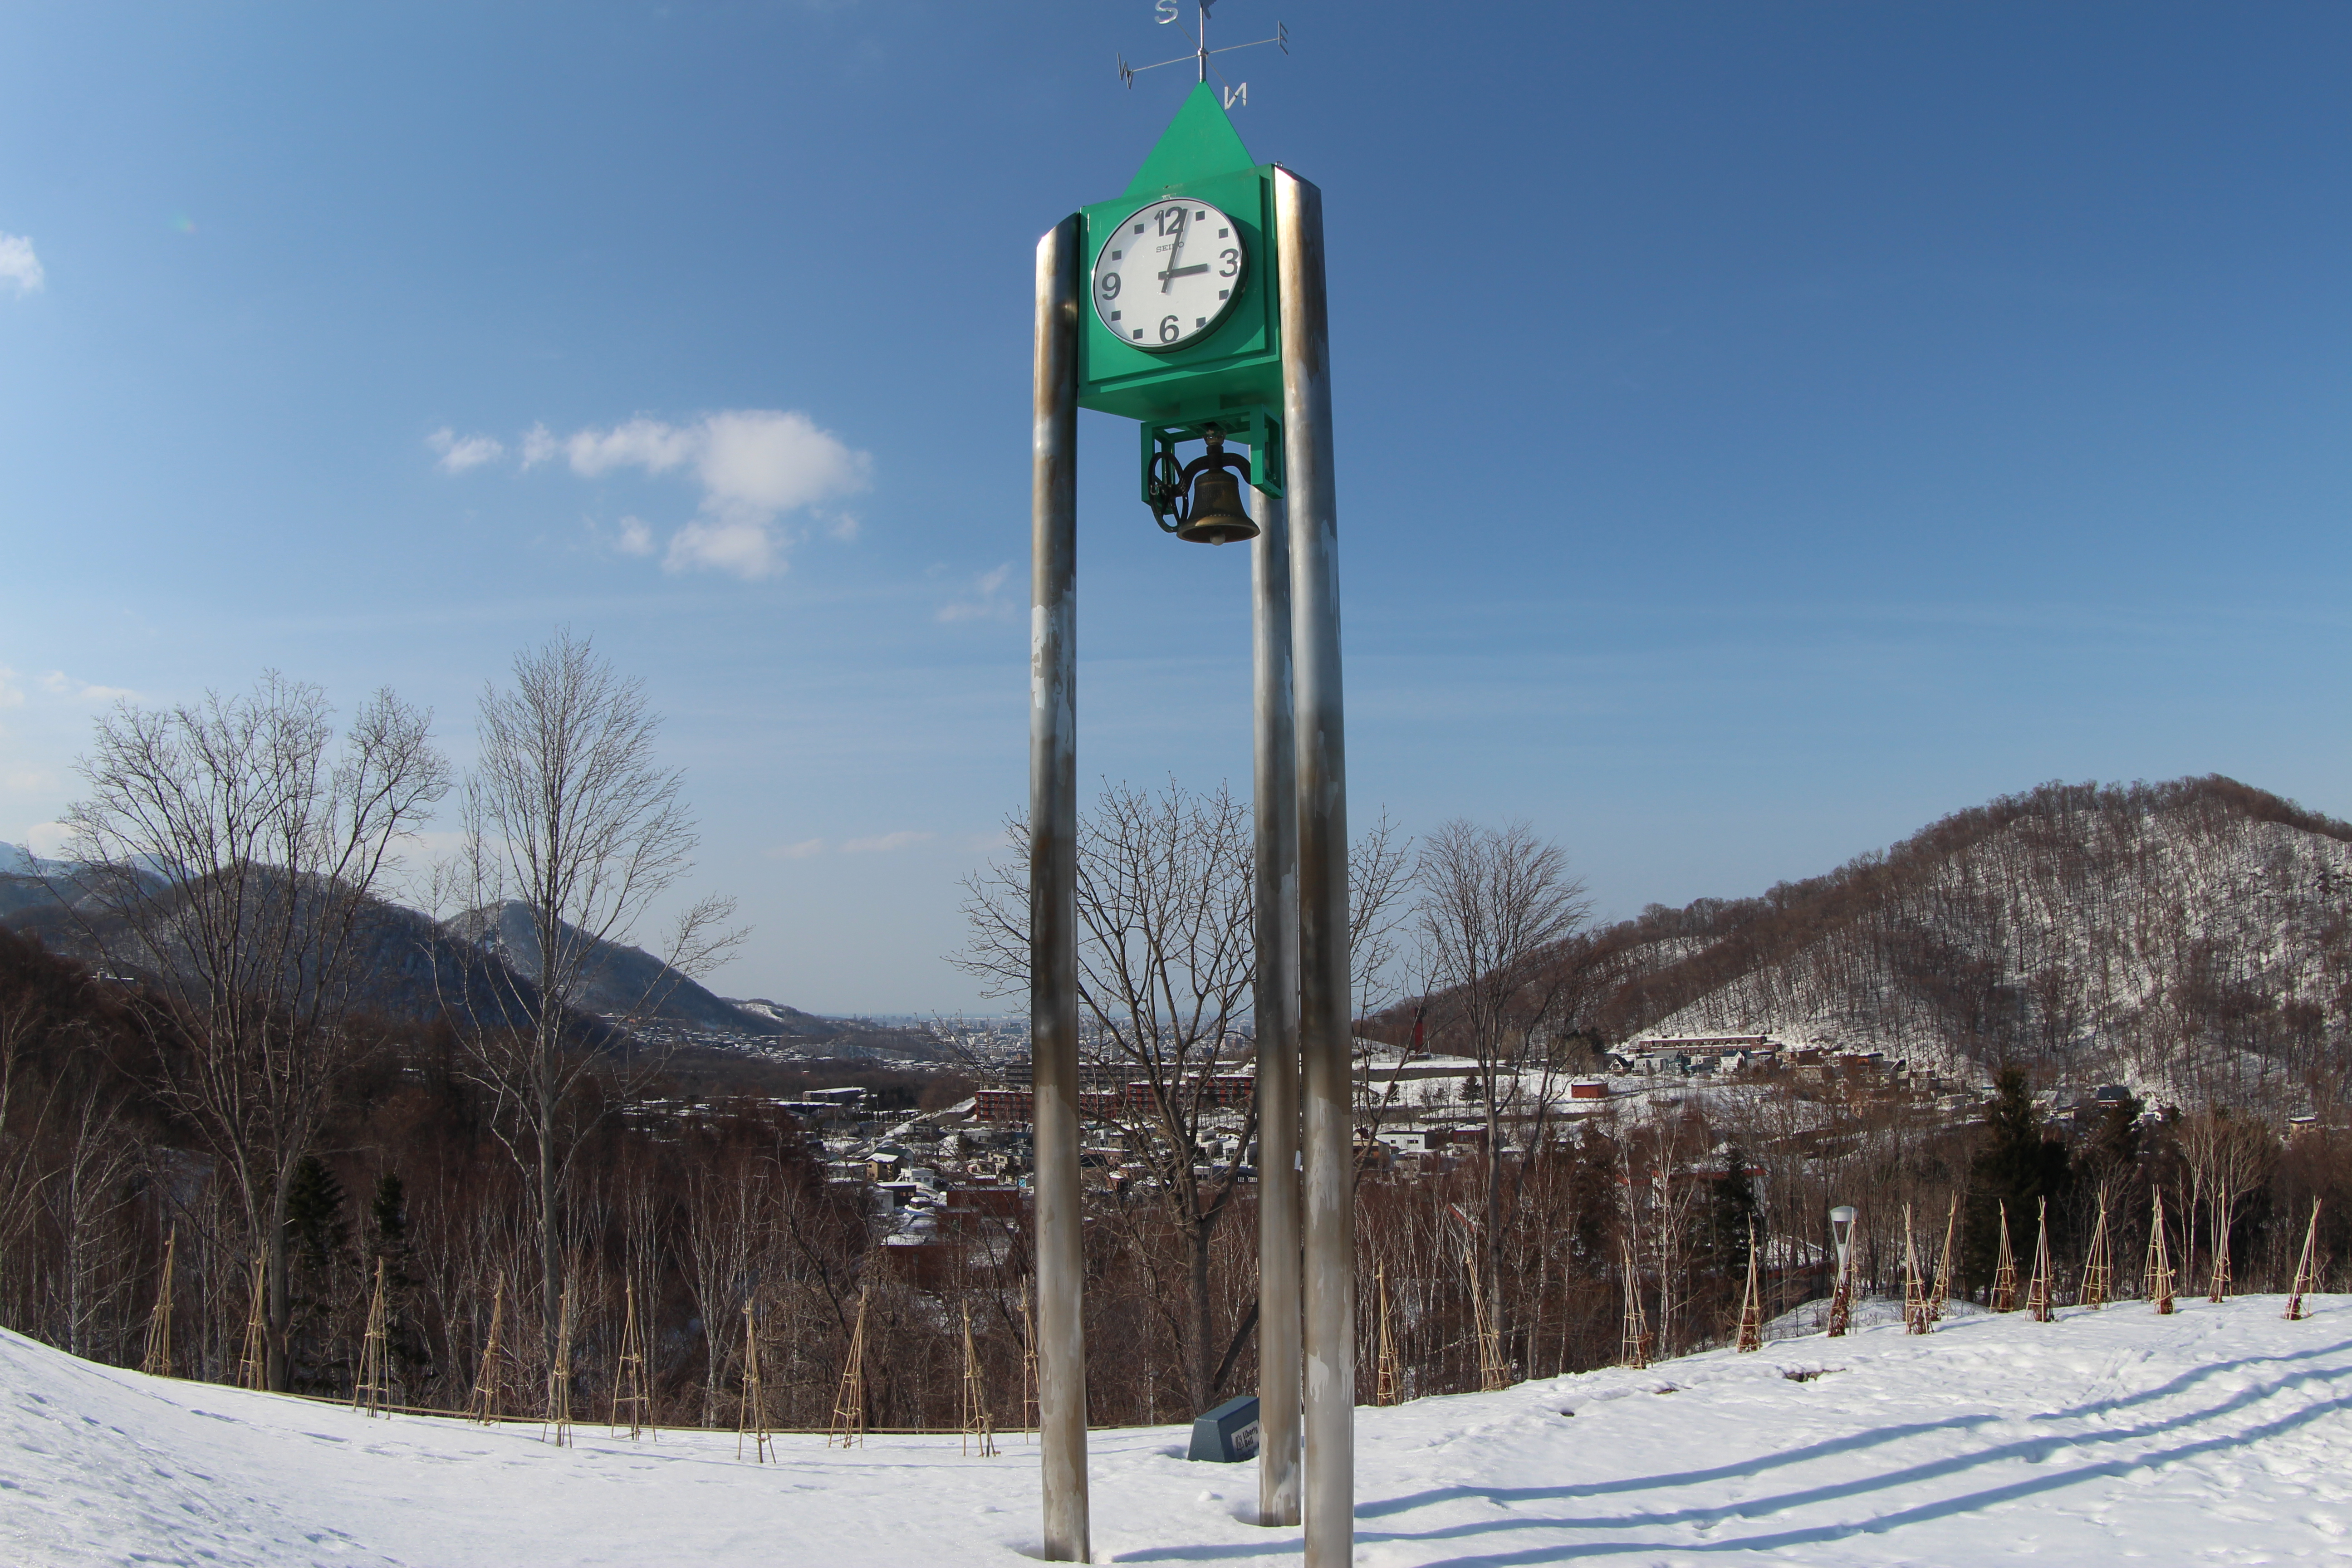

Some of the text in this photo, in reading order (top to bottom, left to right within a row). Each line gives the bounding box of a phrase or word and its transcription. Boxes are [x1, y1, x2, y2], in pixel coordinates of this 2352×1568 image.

[1154, 0, 1178, 24] S
[1278, 20, 1289, 55] E
[1117, 52, 1134, 90] W
[1154, 206, 1184, 237] 12
[1156, 241, 1184, 253] SEIO
[1219, 249, 1239, 277] 3
[1102, 272, 1121, 300] 9
[1159, 315, 1179, 343] 6
[1243, 1426, 1258, 1439] Liberty
[1245, 1436, 1253, 1447] Bell
